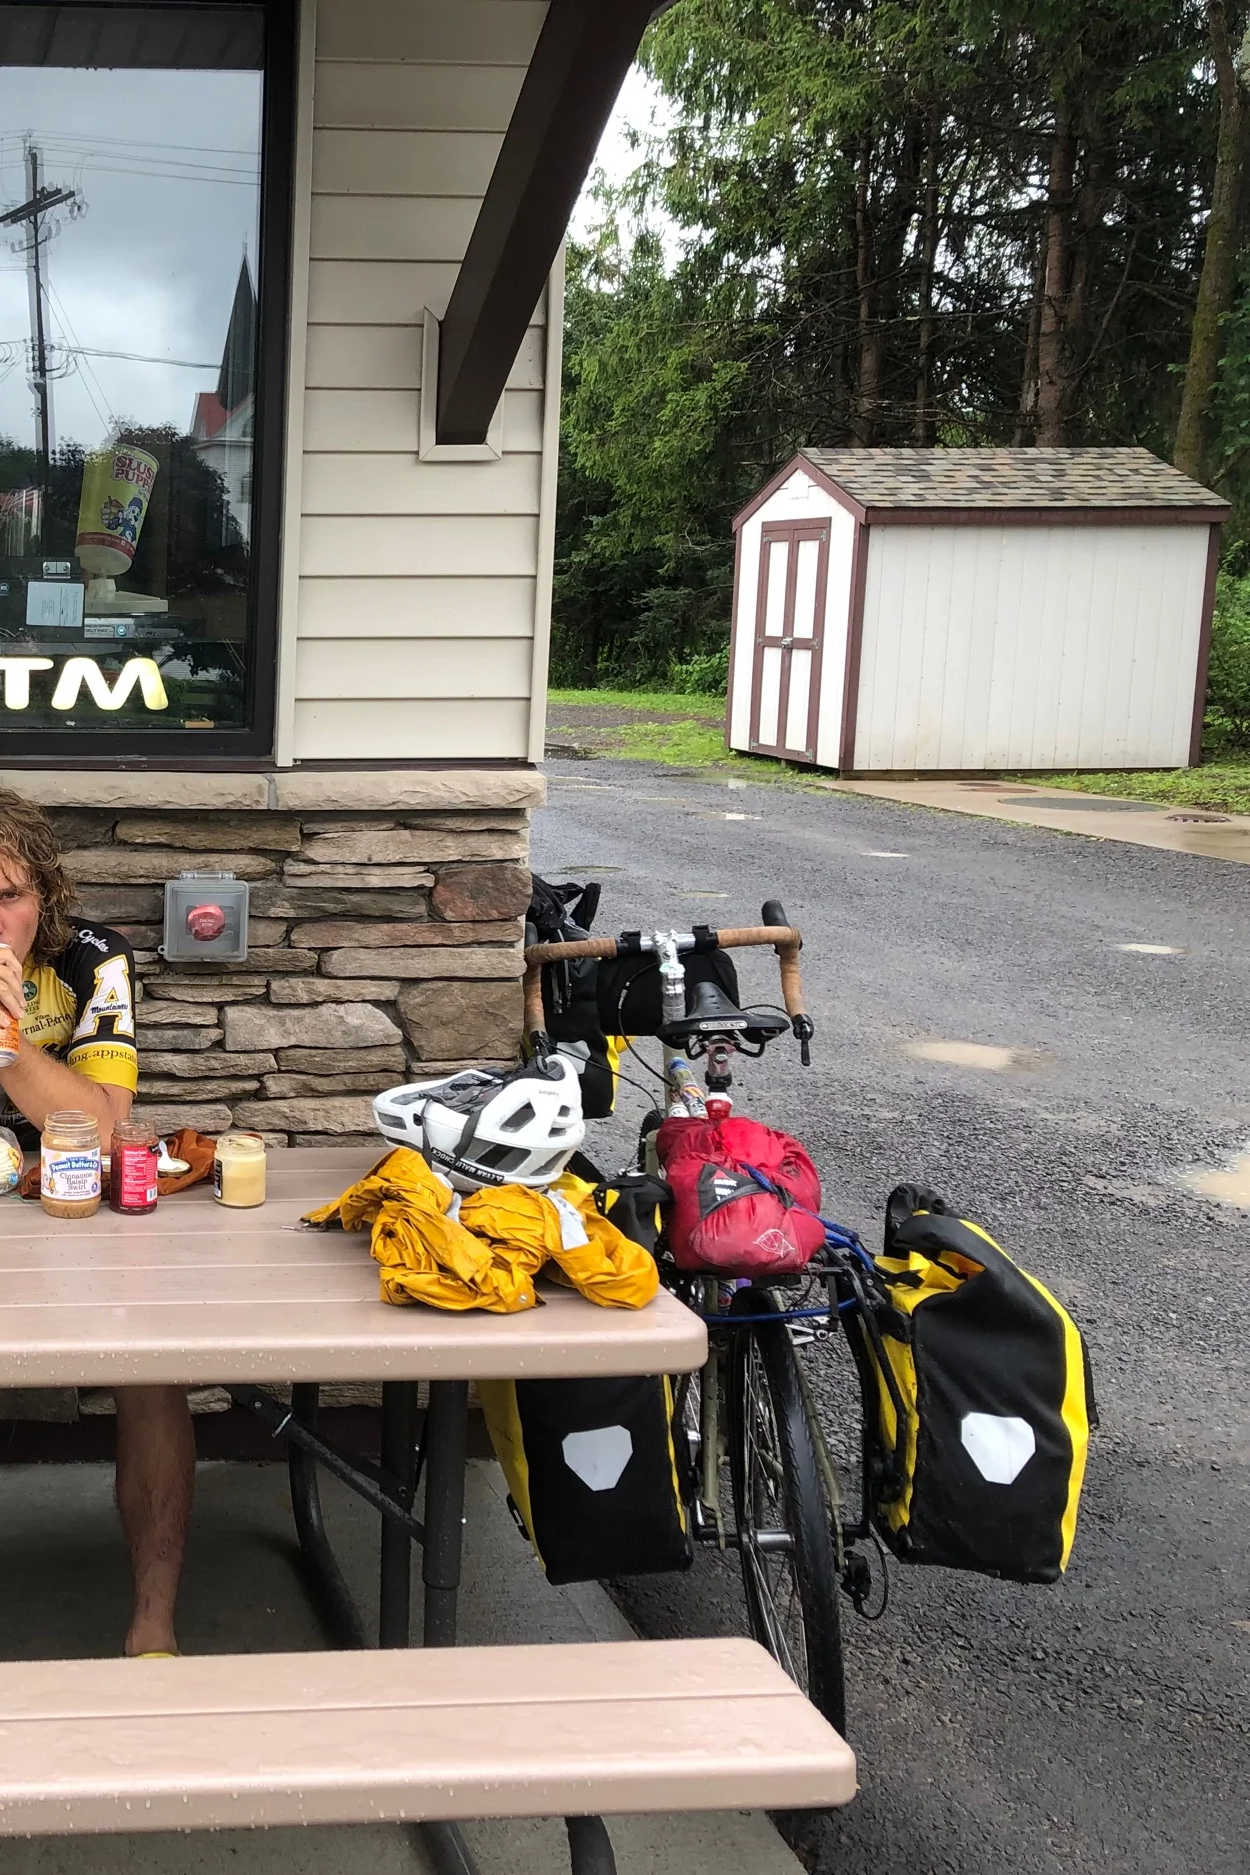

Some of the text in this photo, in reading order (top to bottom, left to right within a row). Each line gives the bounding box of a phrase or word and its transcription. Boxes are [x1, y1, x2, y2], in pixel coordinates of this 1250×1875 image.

[78, 929, 110, 953] Cycles
[51, 1161, 71, 1171] Peanut
[59, 1172, 93, 1180] Cinnamon
[66, 1178, 88, 1186] Raisin
